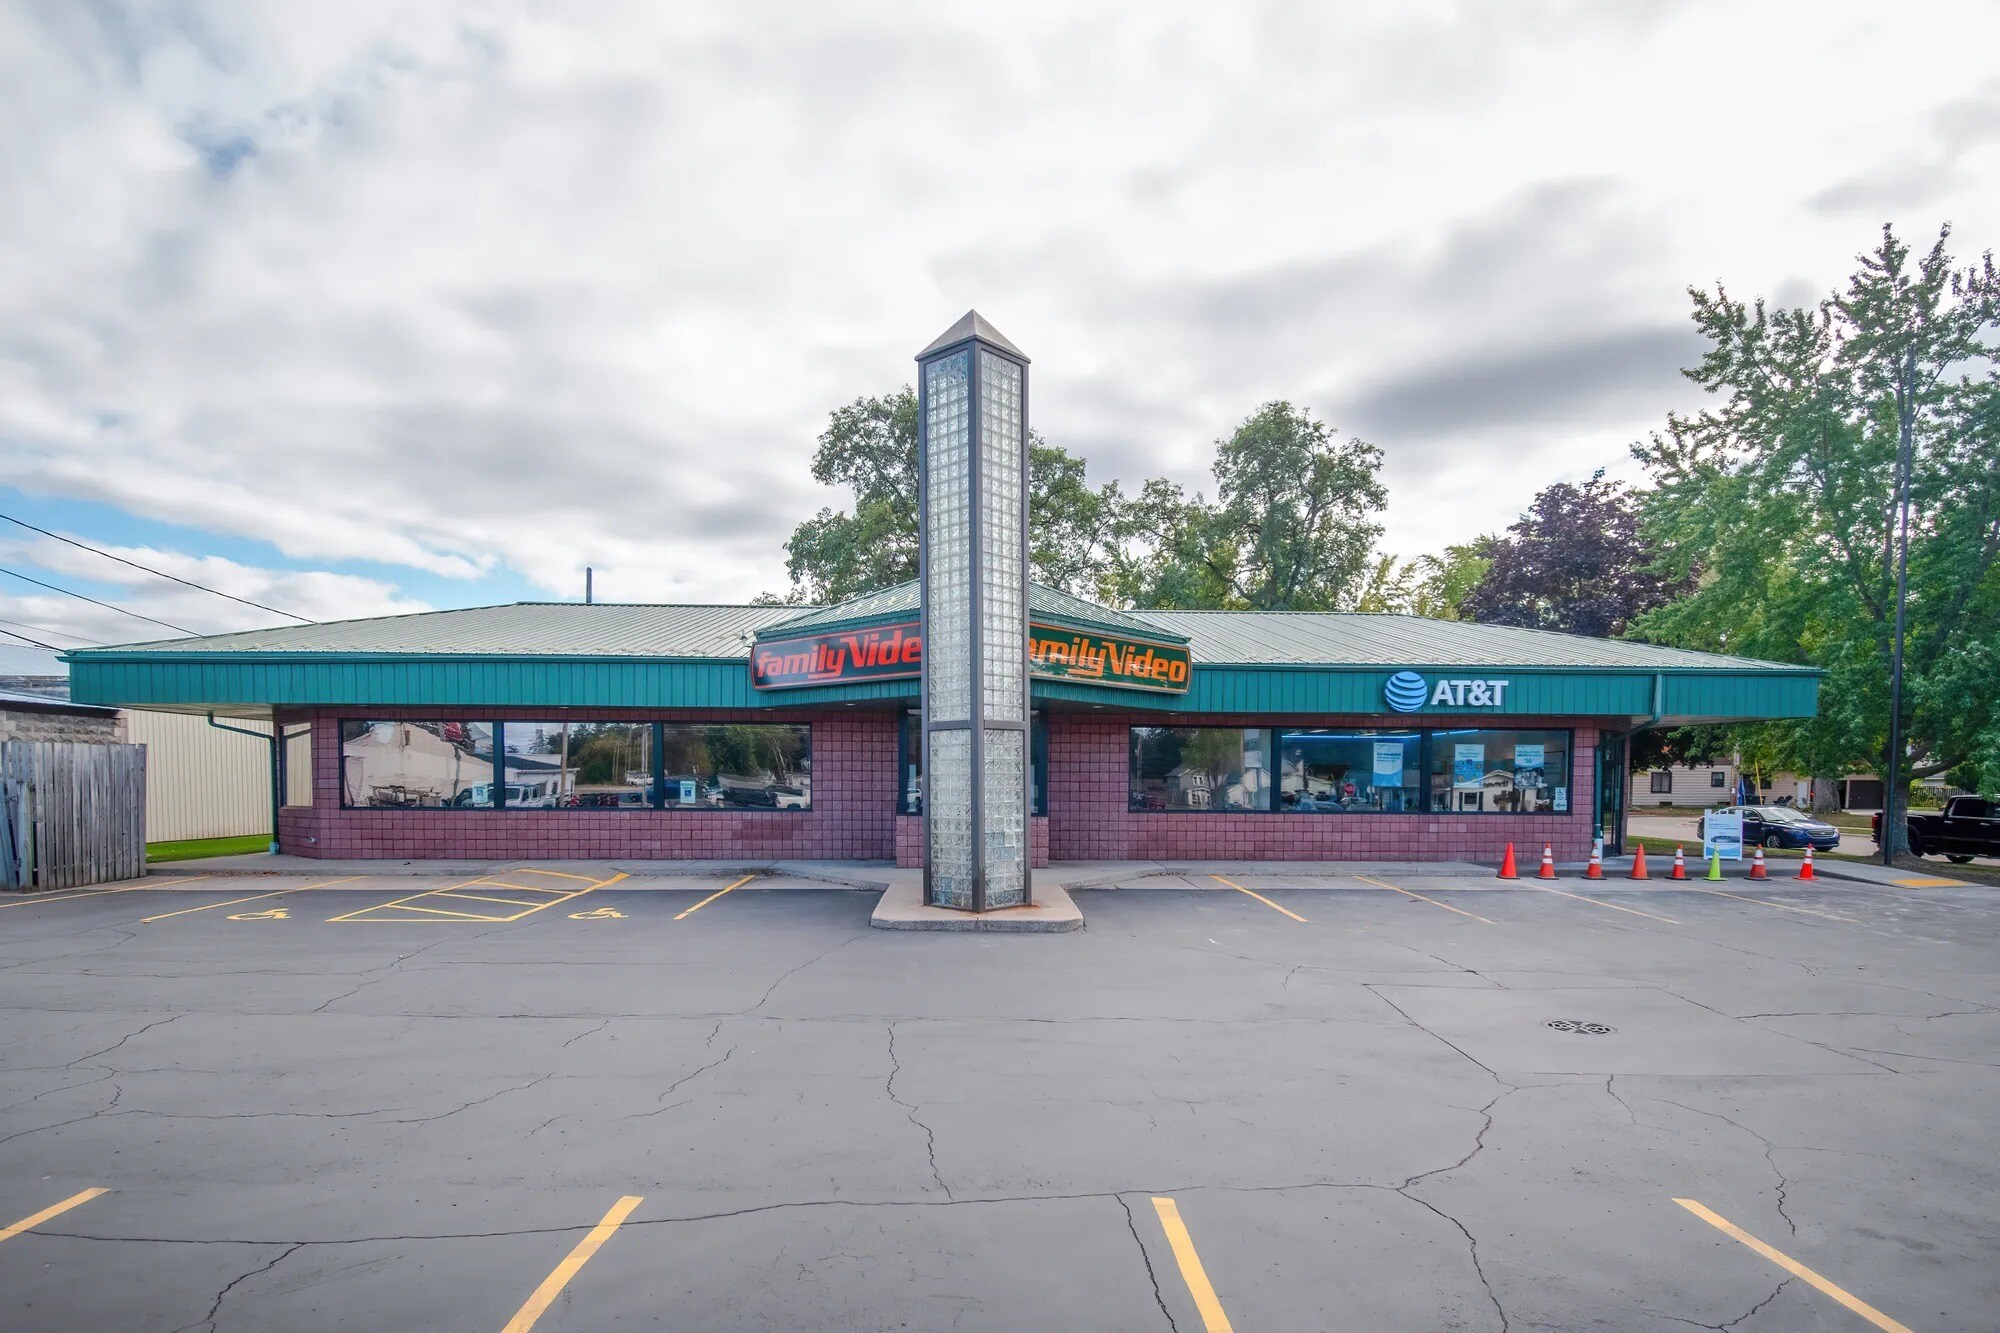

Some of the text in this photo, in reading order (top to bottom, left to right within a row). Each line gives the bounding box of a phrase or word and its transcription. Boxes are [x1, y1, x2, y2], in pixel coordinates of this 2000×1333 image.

[757, 630, 921, 679] family Vide
[1029, 637, 1187, 682] mily Video
[1430, 679, 1509, 706] AT&T
